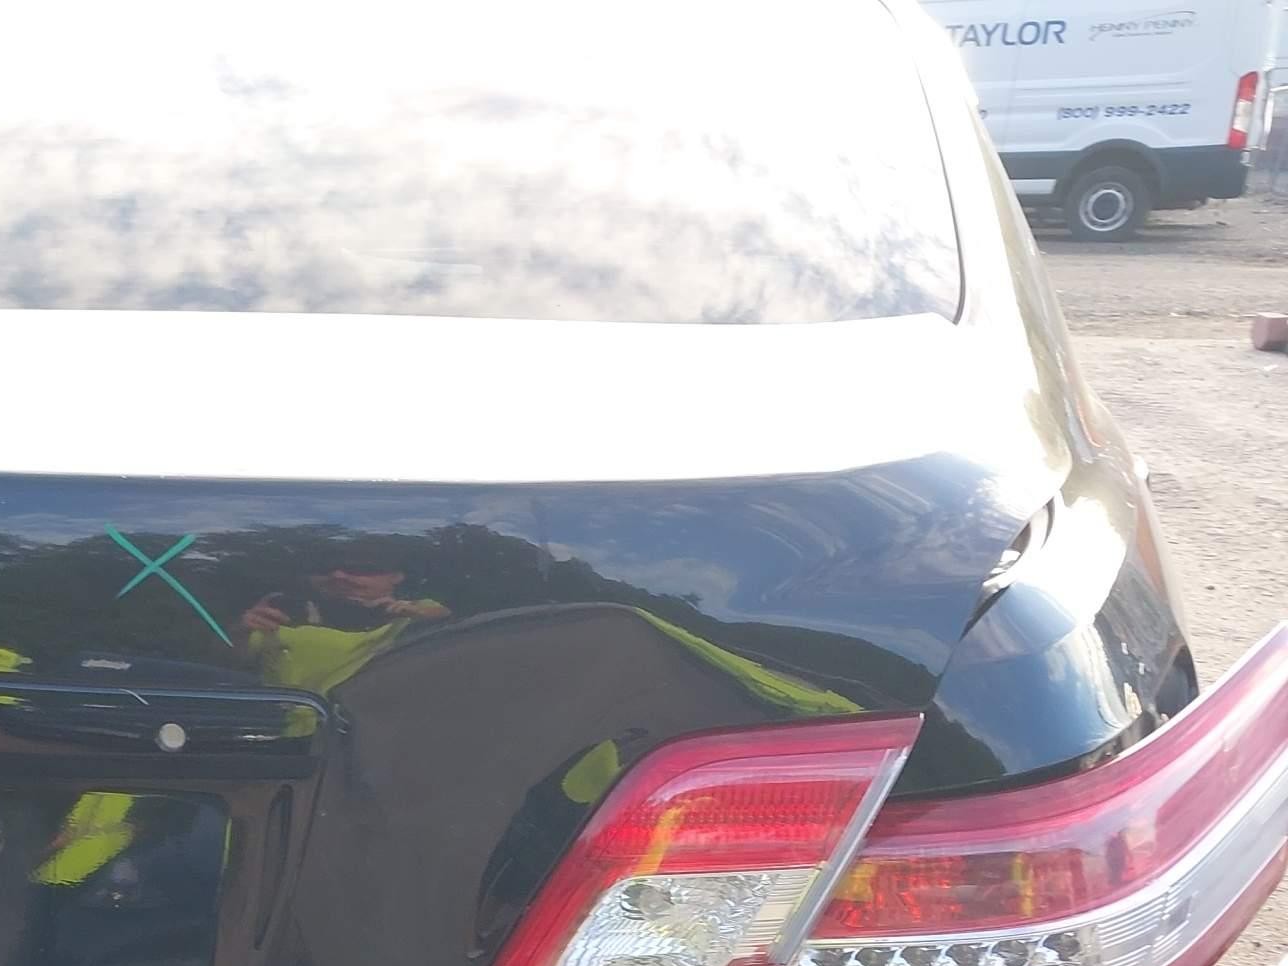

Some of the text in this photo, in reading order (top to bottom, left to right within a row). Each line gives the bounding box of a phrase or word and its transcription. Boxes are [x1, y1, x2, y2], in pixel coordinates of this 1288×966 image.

[945, 20, 1067, 48] TAYLOR
[1057, 103, 1192, 120] (800) 999-2422
